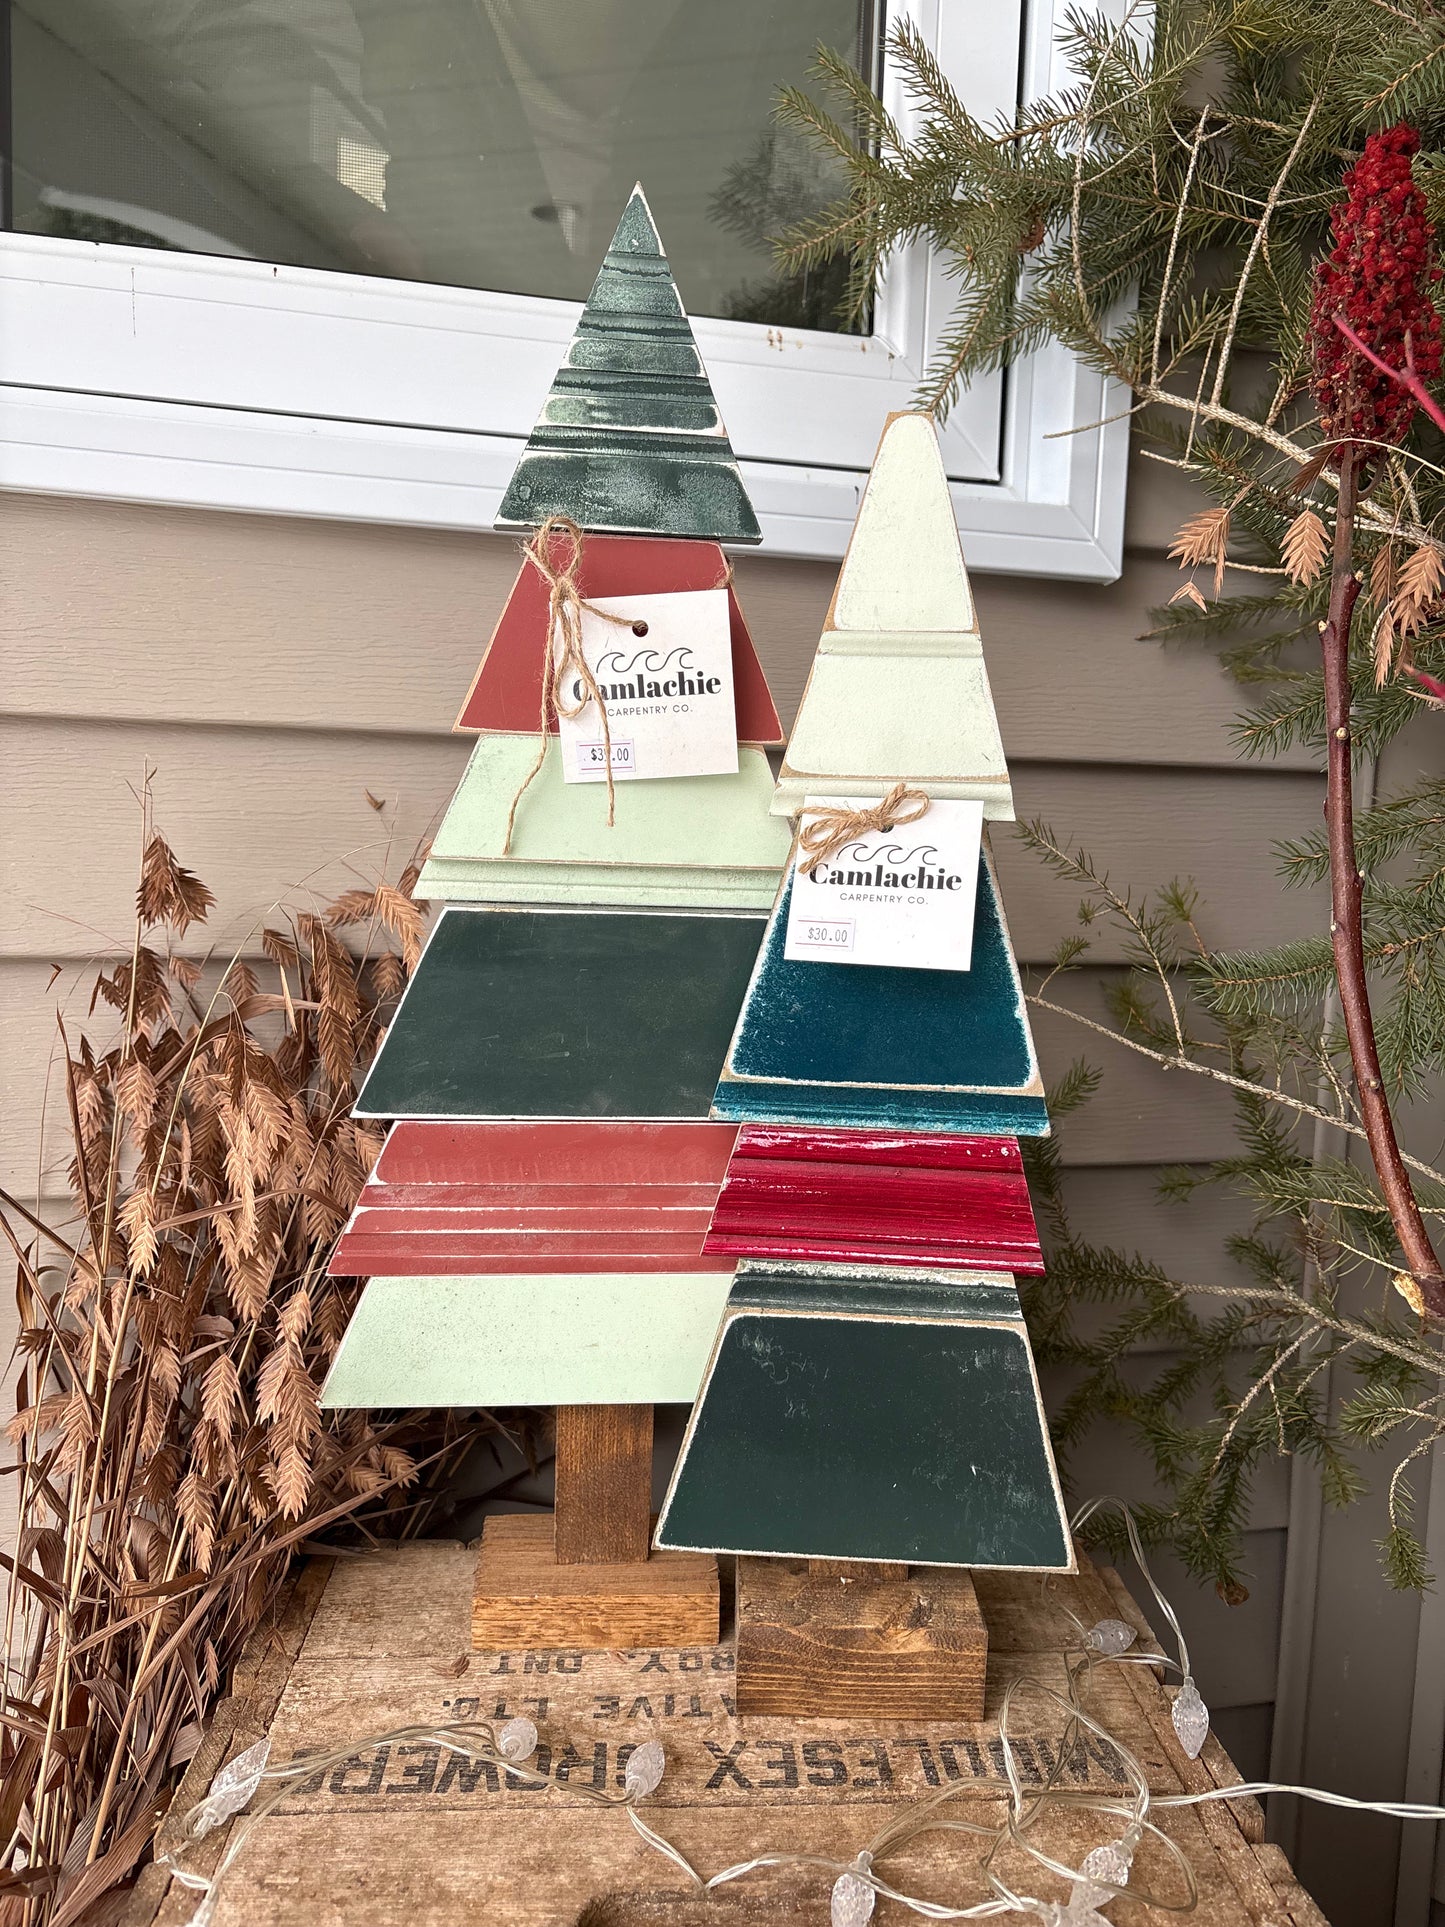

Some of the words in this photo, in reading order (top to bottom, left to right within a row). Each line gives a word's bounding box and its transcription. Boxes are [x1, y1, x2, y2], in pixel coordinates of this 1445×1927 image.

[572, 670, 722, 702] Camlachie
[607, 705, 668, 717] CARPENTRY
[672, 703, 693, 713] CO.
[590, 747, 629, 761] $3.00
[809, 862, 962, 891] Camlachie
[839, 892, 903, 903] CARPENTRY
[908, 896, 928, 905] CO.
[807, 927, 848, 943] $30.00
[702, 1736, 1130, 1790] MIDDLESEX
